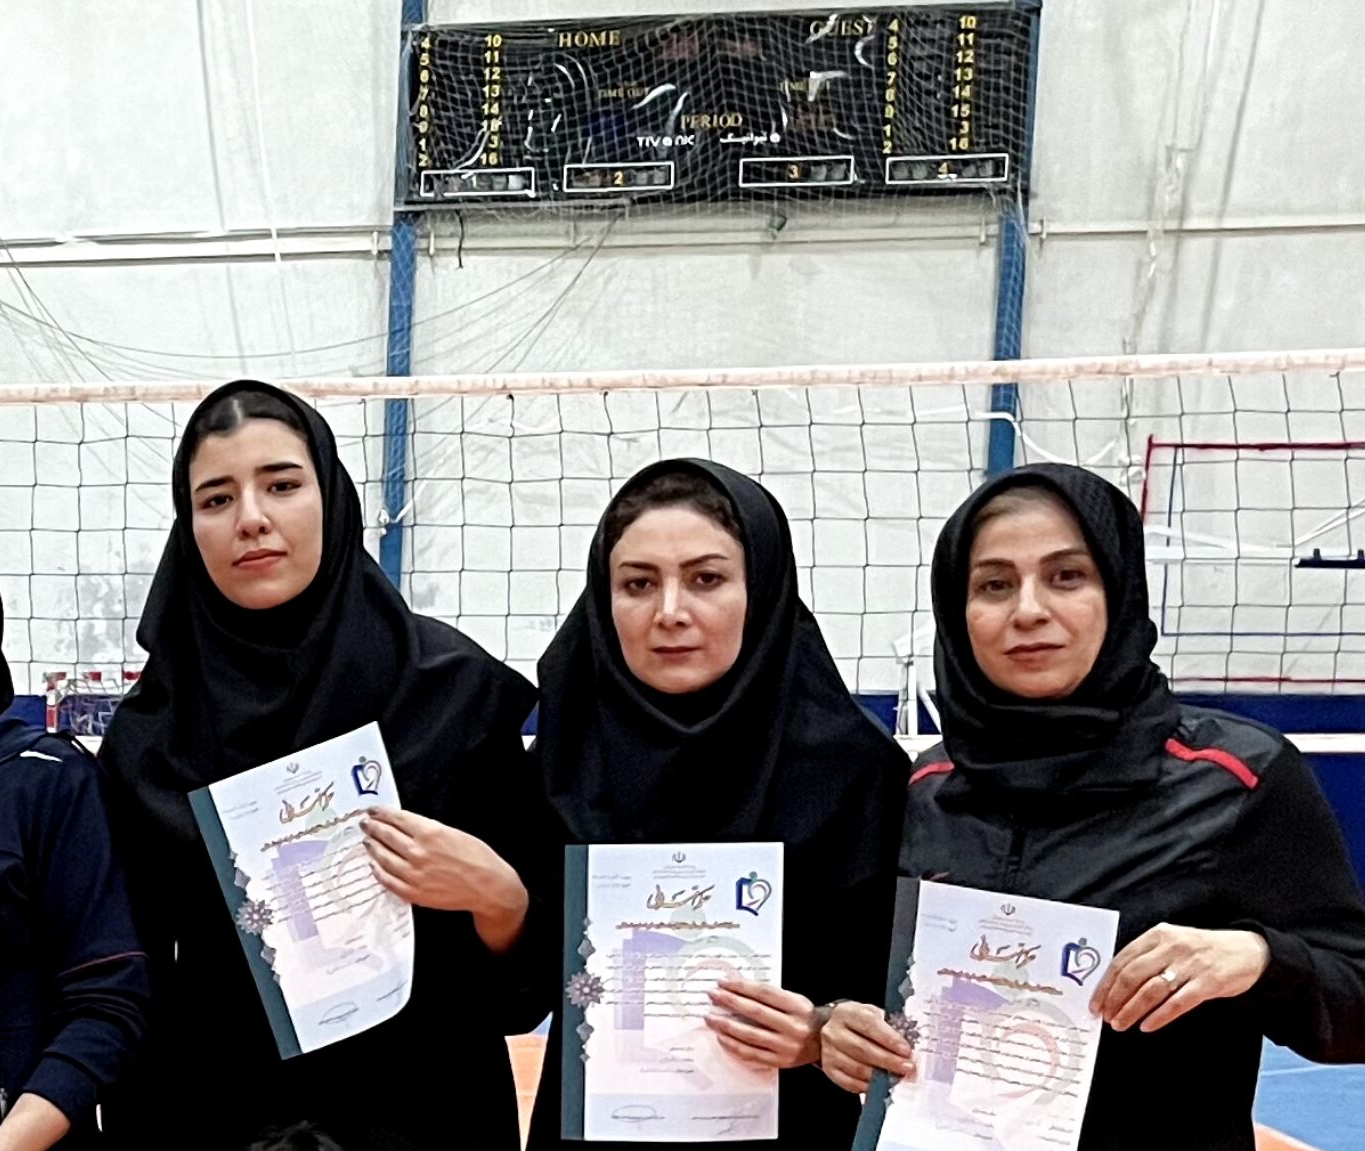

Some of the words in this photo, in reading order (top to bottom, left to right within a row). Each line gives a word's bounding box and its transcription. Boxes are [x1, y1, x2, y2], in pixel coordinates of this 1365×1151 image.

[959, 16, 976, 29] 10
[485, 35, 501, 47] 10
[559, 30, 620, 47] HOME
[958, 33, 974, 45] 11
[485, 51, 499, 63] 11
[957, 50, 974, 63] 12
[484, 68, 500, 80] 12
[955, 68, 973, 80] 13
[482, 85, 500, 98] 13
[954, 85, 970, 98] 14
[482, 103, 499, 115] 14
[951, 104, 970, 117] 15
[681, 112, 743, 129] PERIOD
[950, 137, 968, 150] 16
[481, 153, 498, 165] 16
[788, 165, 799, 178] 3
[938, 162, 949, 175] 4
[614, 173, 624, 184] 2
